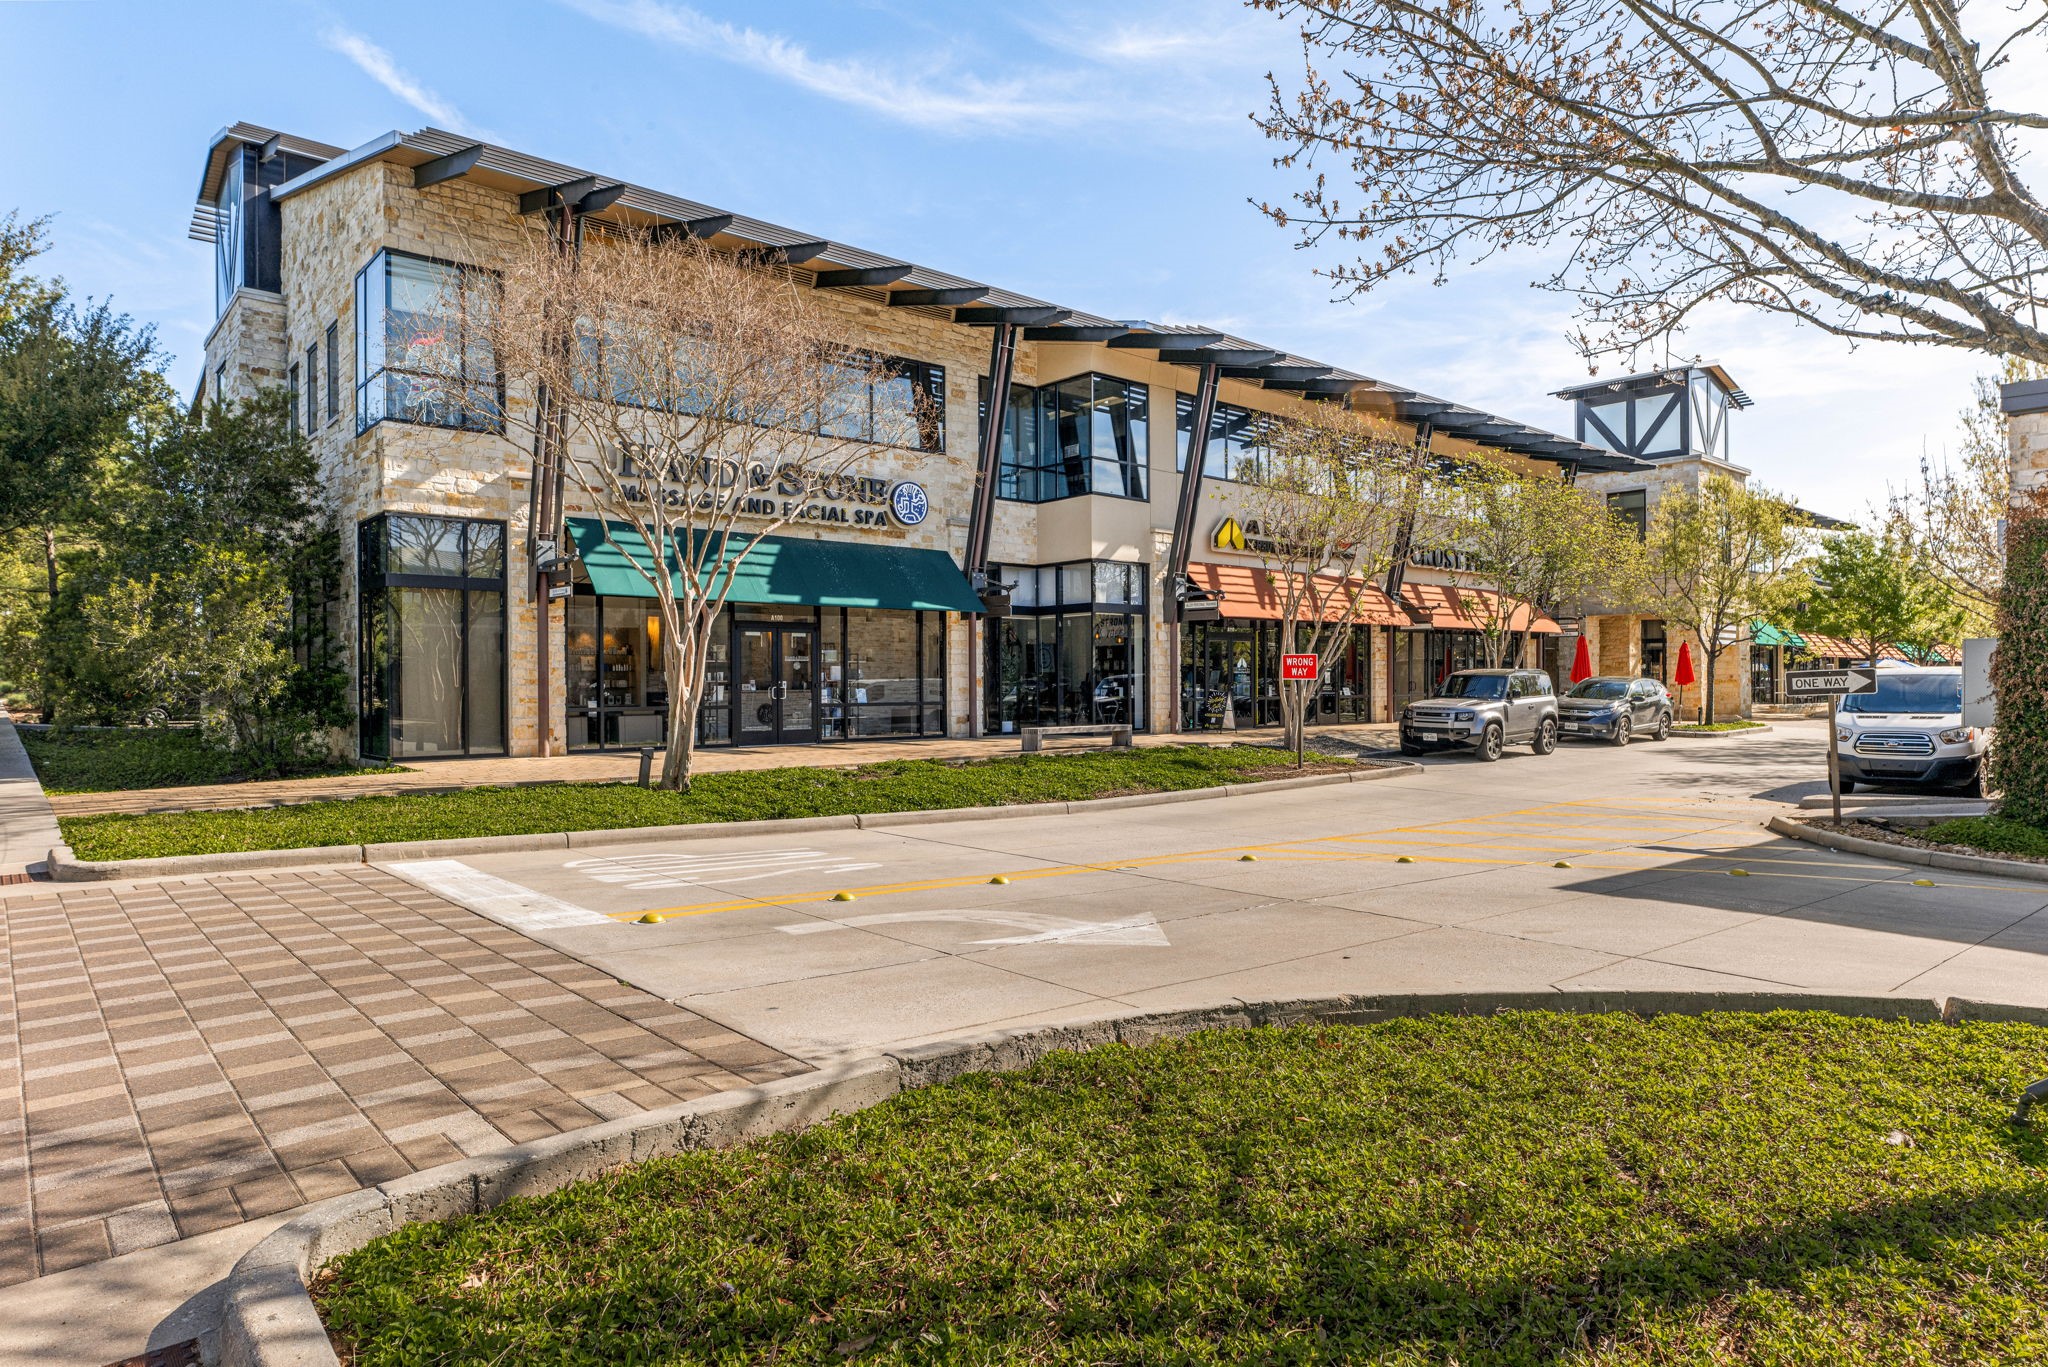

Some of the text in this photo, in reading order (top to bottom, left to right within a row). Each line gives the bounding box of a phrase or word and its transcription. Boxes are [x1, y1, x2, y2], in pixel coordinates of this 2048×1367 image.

[750, 463, 771, 491] &
[732, 496, 776, 515] AND
[854, 509, 888, 527] SPA
[1286, 657, 1314, 666] WRONG
[1291, 667, 1308, 676] WAY
[1795, 677, 1848, 689] ONE WAY
